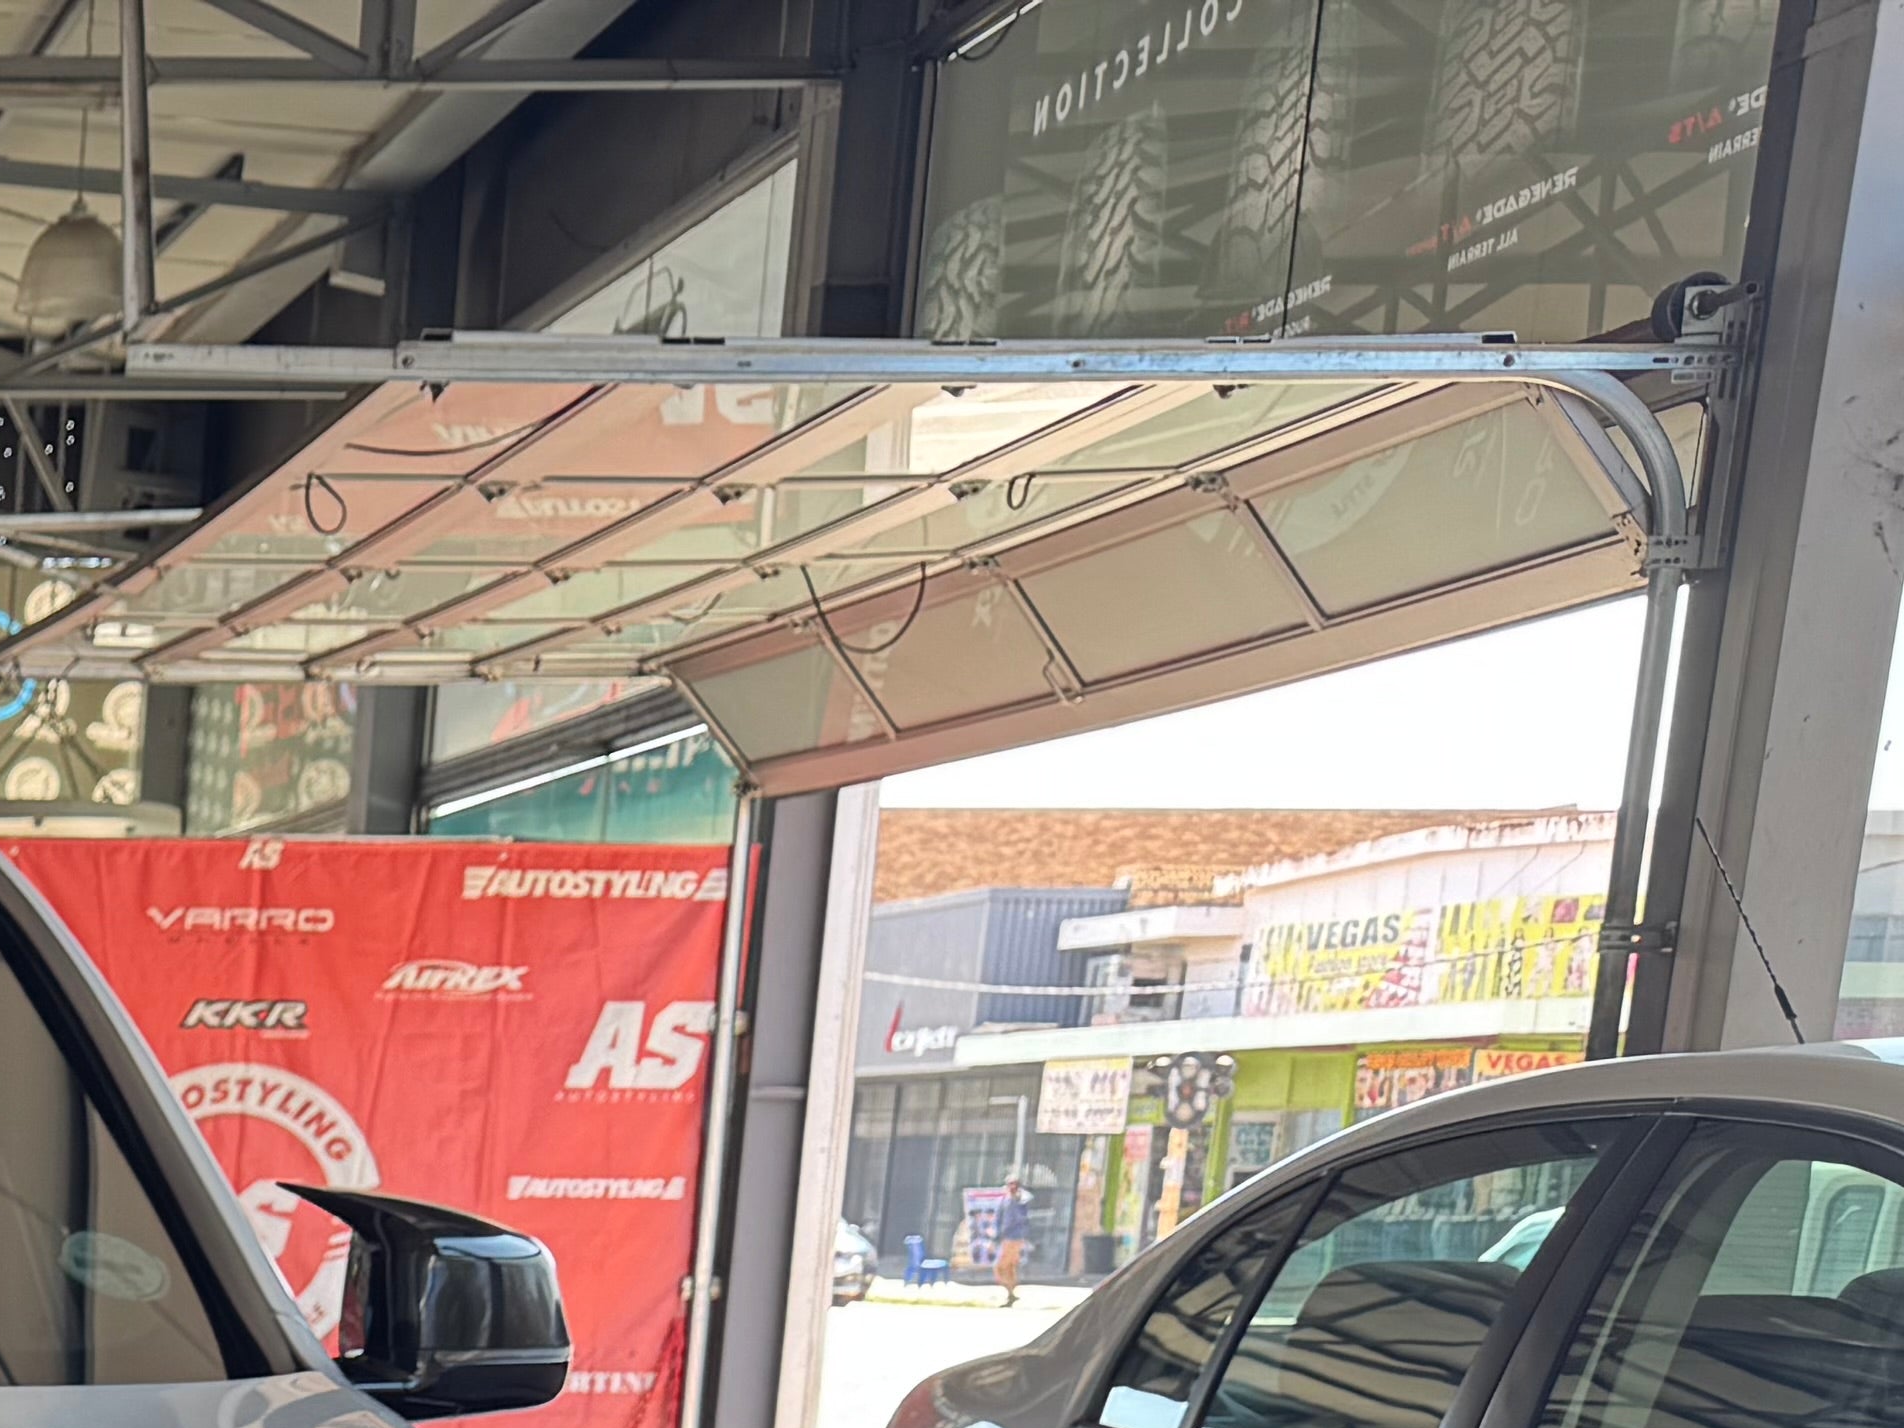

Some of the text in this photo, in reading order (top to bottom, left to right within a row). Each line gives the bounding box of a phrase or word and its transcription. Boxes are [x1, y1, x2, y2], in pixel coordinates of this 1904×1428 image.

[488, 868, 701, 899] AUTOSTYLING
[146, 906, 335, 933] VARRO
[1306, 914, 1401, 951] VEGAS
[181, 999, 307, 1029] KKR
[564, 1001, 717, 1090] AS
[525, 1178, 665, 1199] AUTOSTYLING
